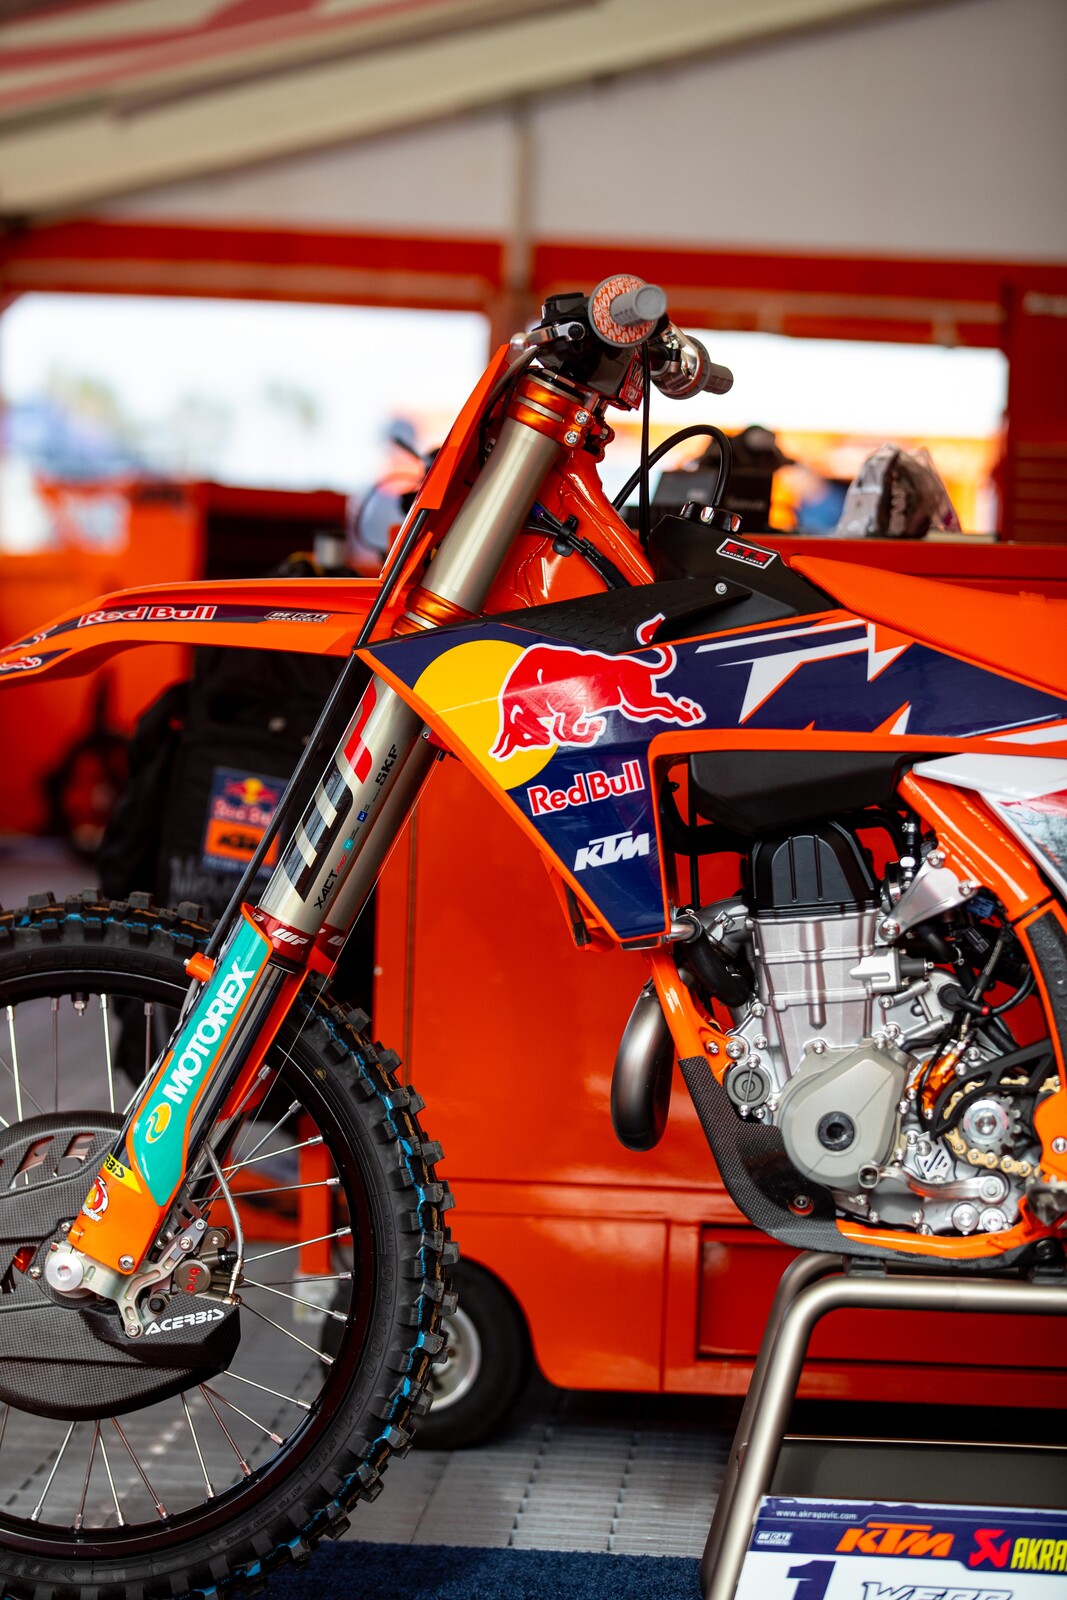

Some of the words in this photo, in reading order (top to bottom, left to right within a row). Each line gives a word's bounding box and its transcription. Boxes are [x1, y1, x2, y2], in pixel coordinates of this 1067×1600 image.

[721, 550, 745, 559] RACING
[745, 557, 764, 565] FUELS
[725, 543, 770, 562] ETS
[79, 607, 147, 627] Red
[149, 606, 217, 620] Bull
[375, 744, 398, 787] SKF
[528, 774, 588, 815] Red
[587, 761, 644, 801] Bull
[573, 830, 650, 872] KTM
[314, 869, 338, 909] XACT
[271, 928, 309, 946] WP
[162, 961, 256, 1104] MOTOREX
[290, 1485, 303, 1499] NOT
[775, 1509, 858, 1520] www.akrapovic.com
[834, 1521, 955, 1558] KTM
